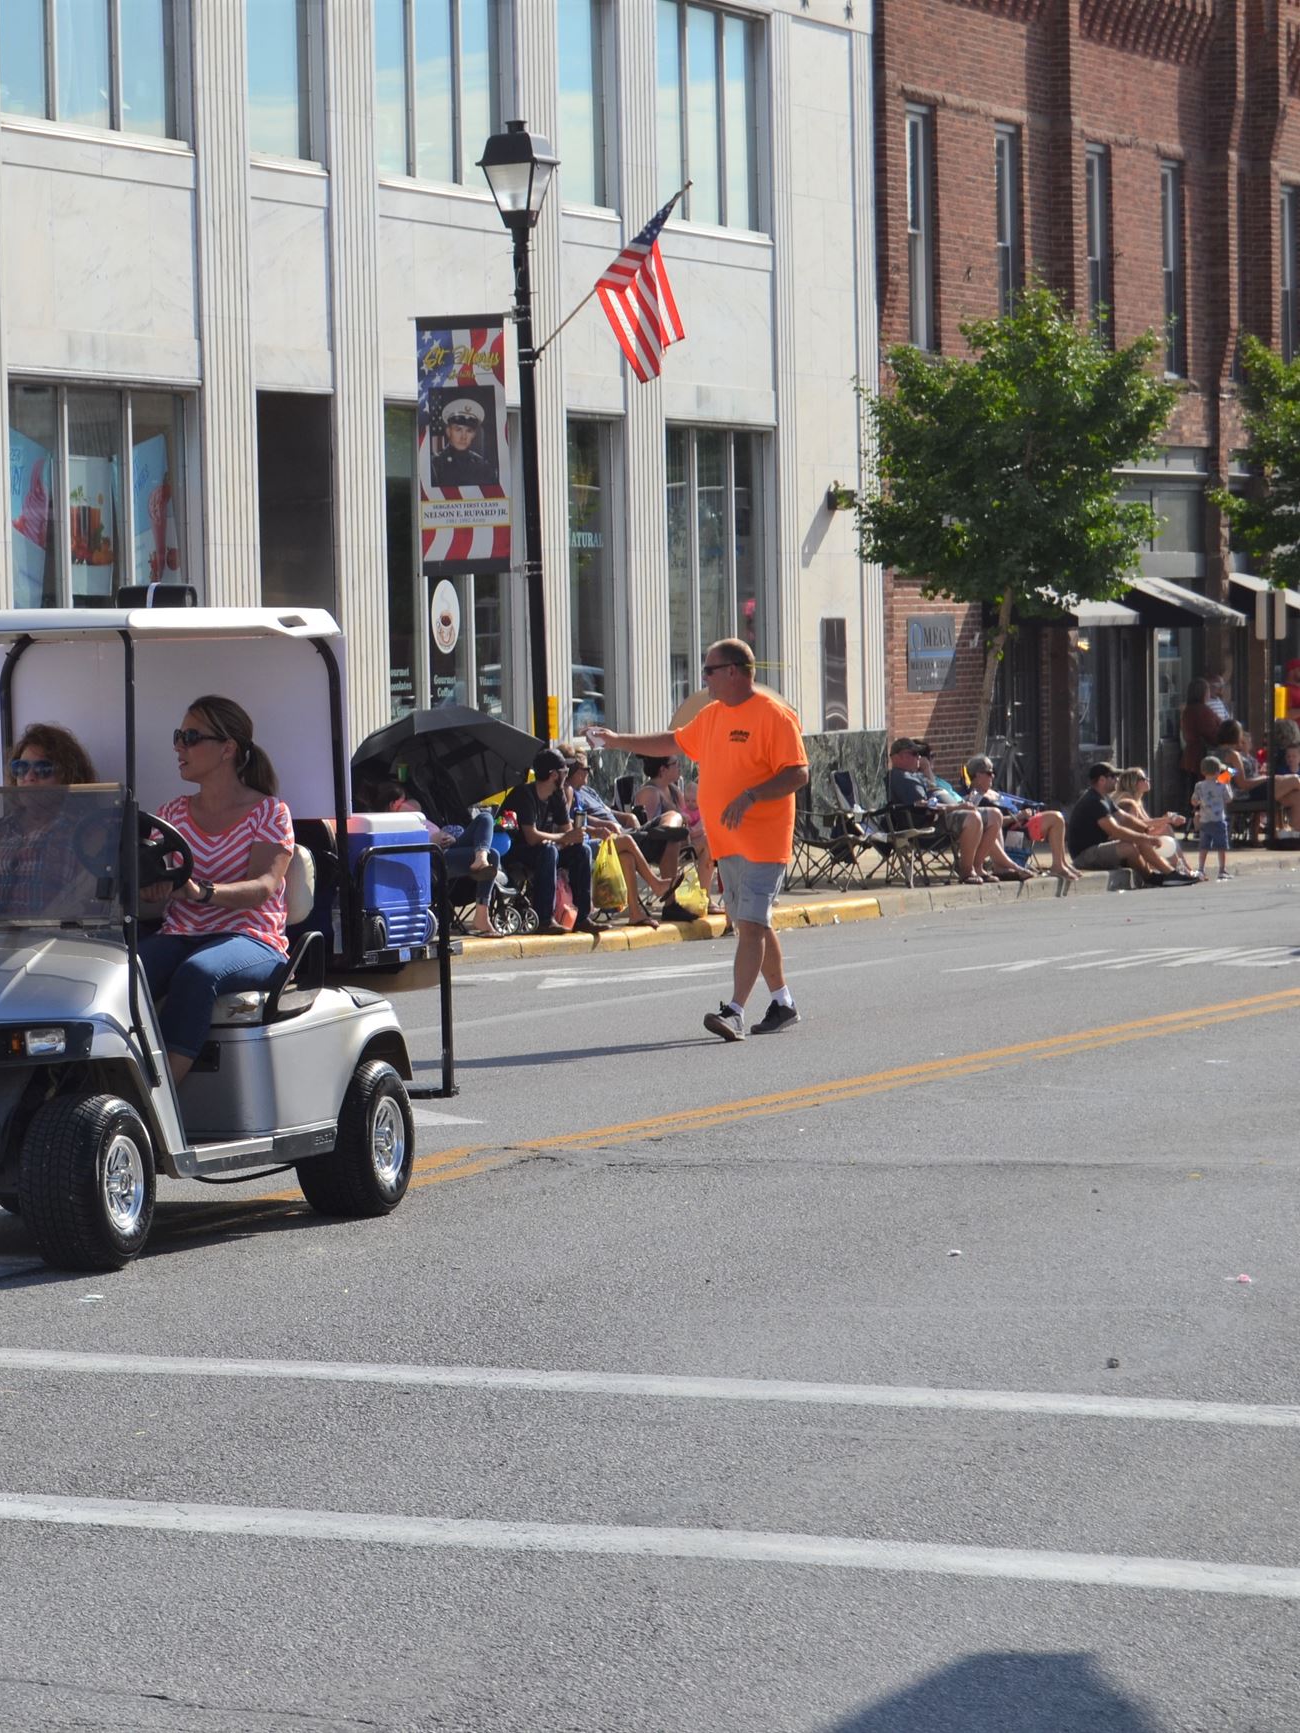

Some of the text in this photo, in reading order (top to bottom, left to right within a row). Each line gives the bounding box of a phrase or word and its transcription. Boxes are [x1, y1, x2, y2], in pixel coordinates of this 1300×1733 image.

[424, 510, 455, 519] NELSON
[464, 508, 496, 517] RUPARD
[569, 530, 604, 548] ATURAL
[434, 674, 457, 685] Gourmet
